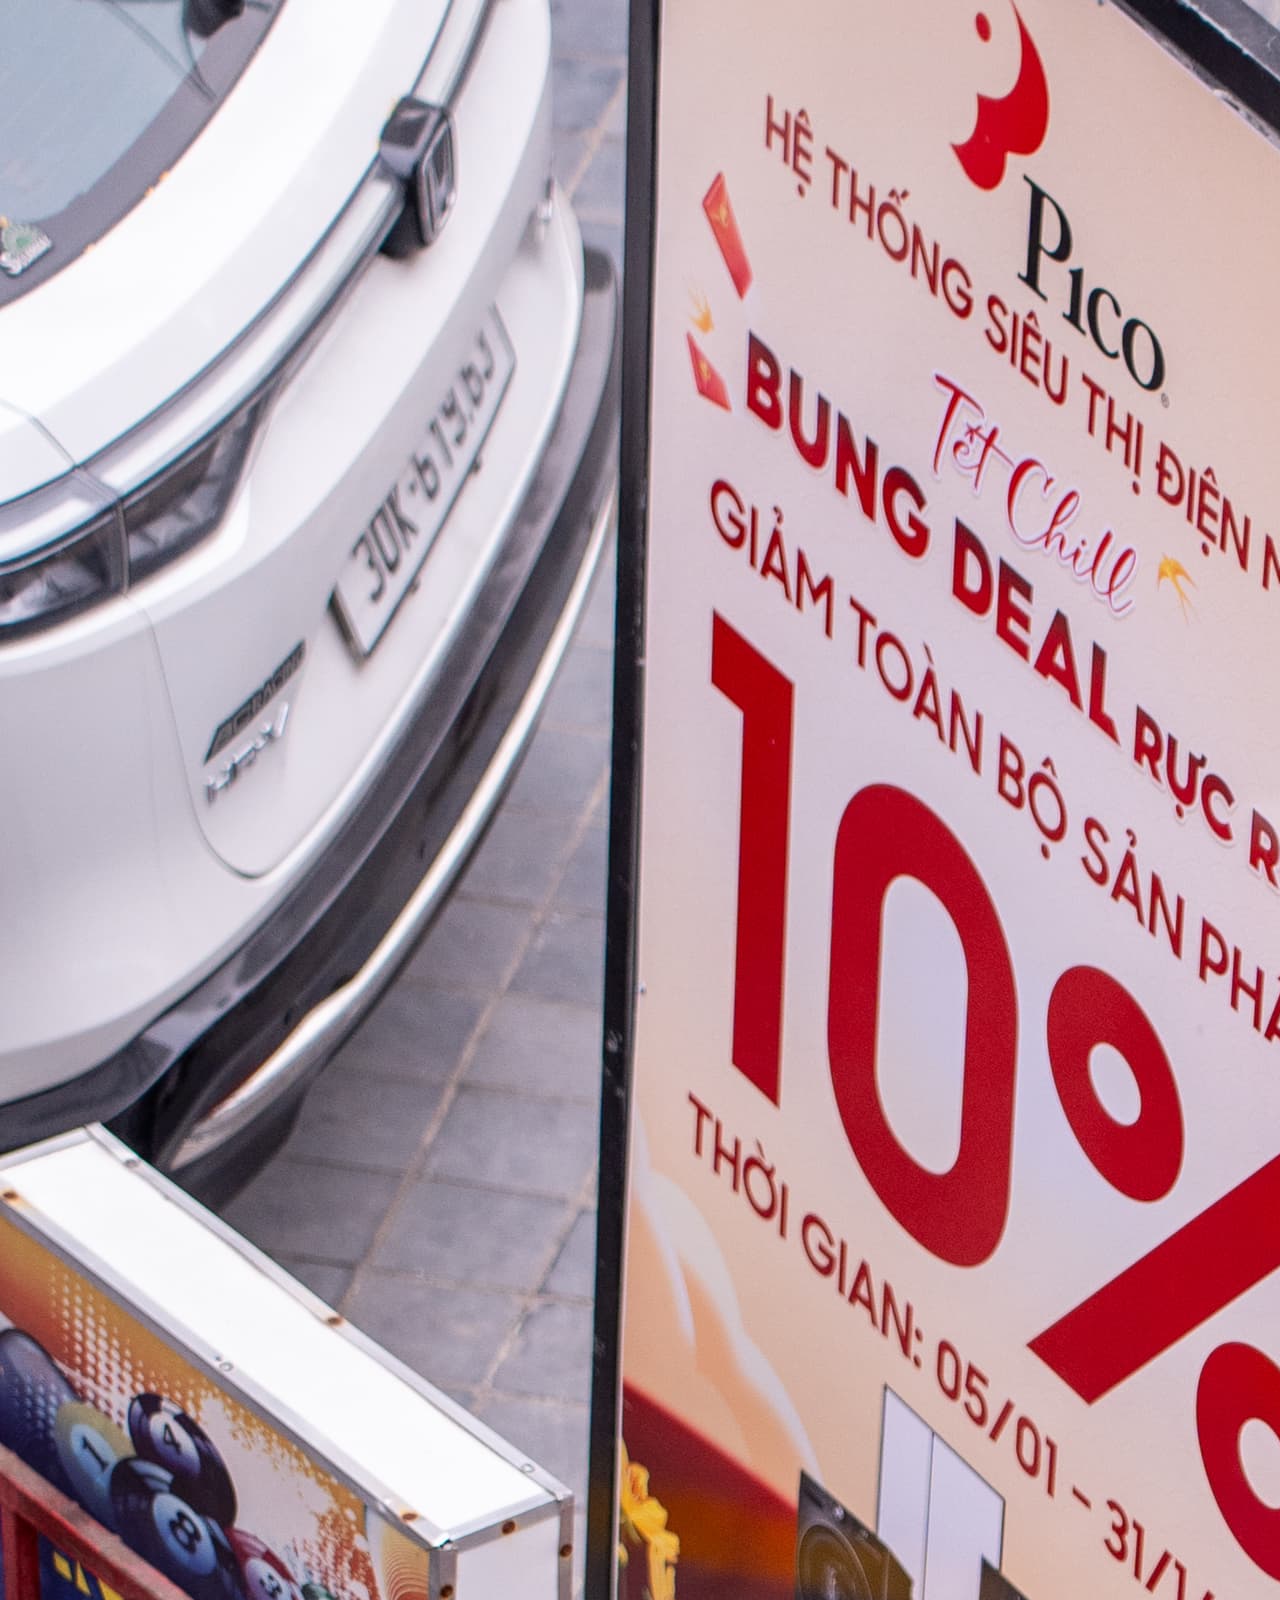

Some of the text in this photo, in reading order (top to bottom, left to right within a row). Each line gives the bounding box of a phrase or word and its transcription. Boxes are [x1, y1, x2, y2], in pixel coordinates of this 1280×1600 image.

[765, 93, 813, 198] HỆ
[825, 145, 974, 319] THỐNG
[984, 294, 1069, 406] SIÊU
[1082, 371, 1144, 496] THỊ
[1156, 440, 1251, 573] ĐIỆN
[1007, 457, 1137, 613] Chill
[710, 478, 834, 640] GIẢM
[849, 595, 984, 777] TOÀN
[997, 732, 1068, 860] BỘ
[1081, 816, 1185, 960] SẢN
[747, 329, 931, 559] BUNG
[951, 515, 1121, 746] DEAL
[1134, 704, 1236, 842] RỰC
[689, 1090, 789, 1240] THỜI
[802, 1213, 924, 1370] GIAN:
[936, 1338, 1059, 1499] 05/01
[168, 1510, 203, 1554] 8
